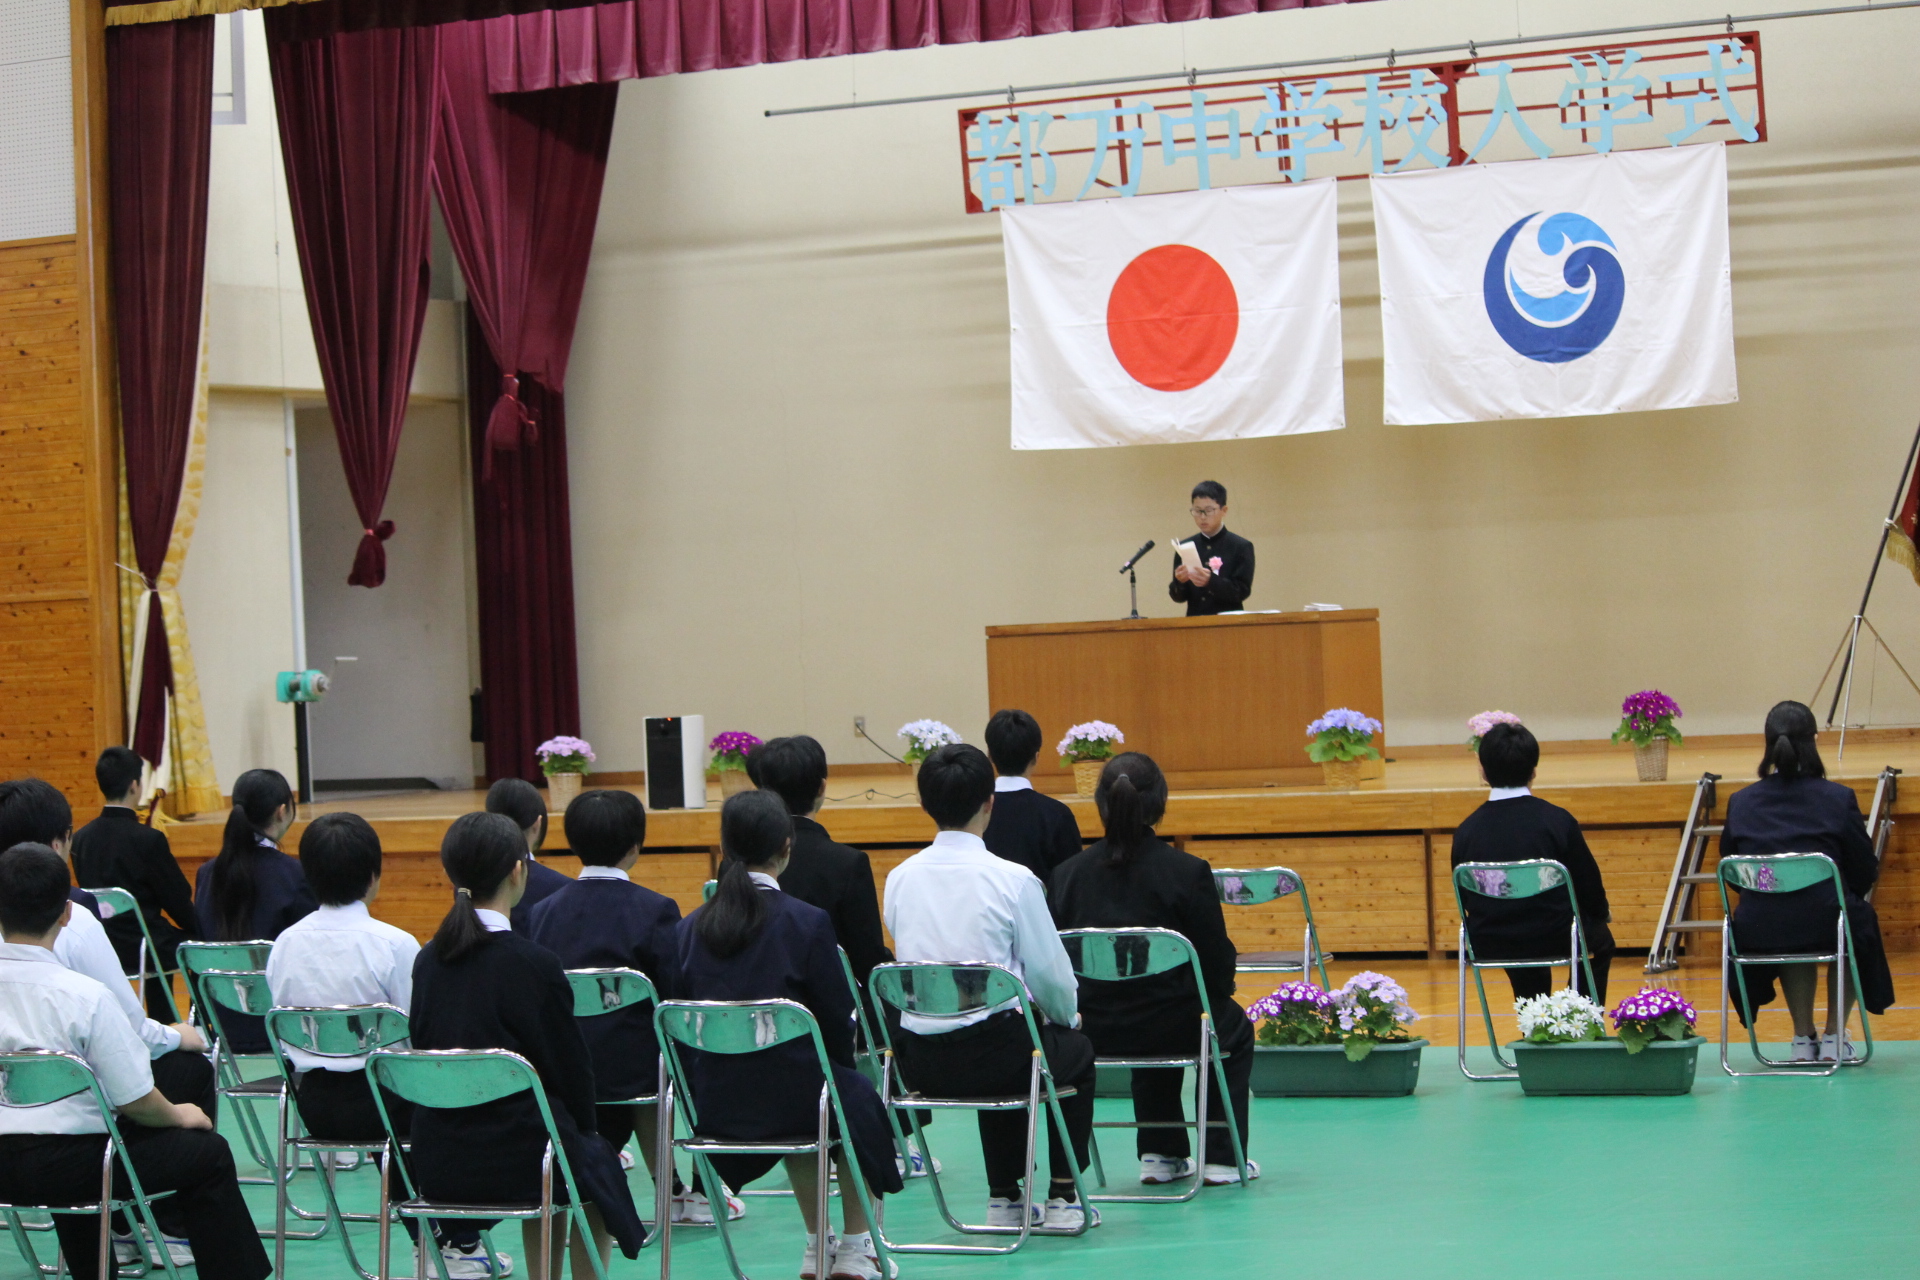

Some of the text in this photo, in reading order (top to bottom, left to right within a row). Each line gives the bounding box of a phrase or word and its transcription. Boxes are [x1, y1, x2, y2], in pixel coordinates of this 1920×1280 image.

[967, 42, 1759, 212] 都万中学校入学式
